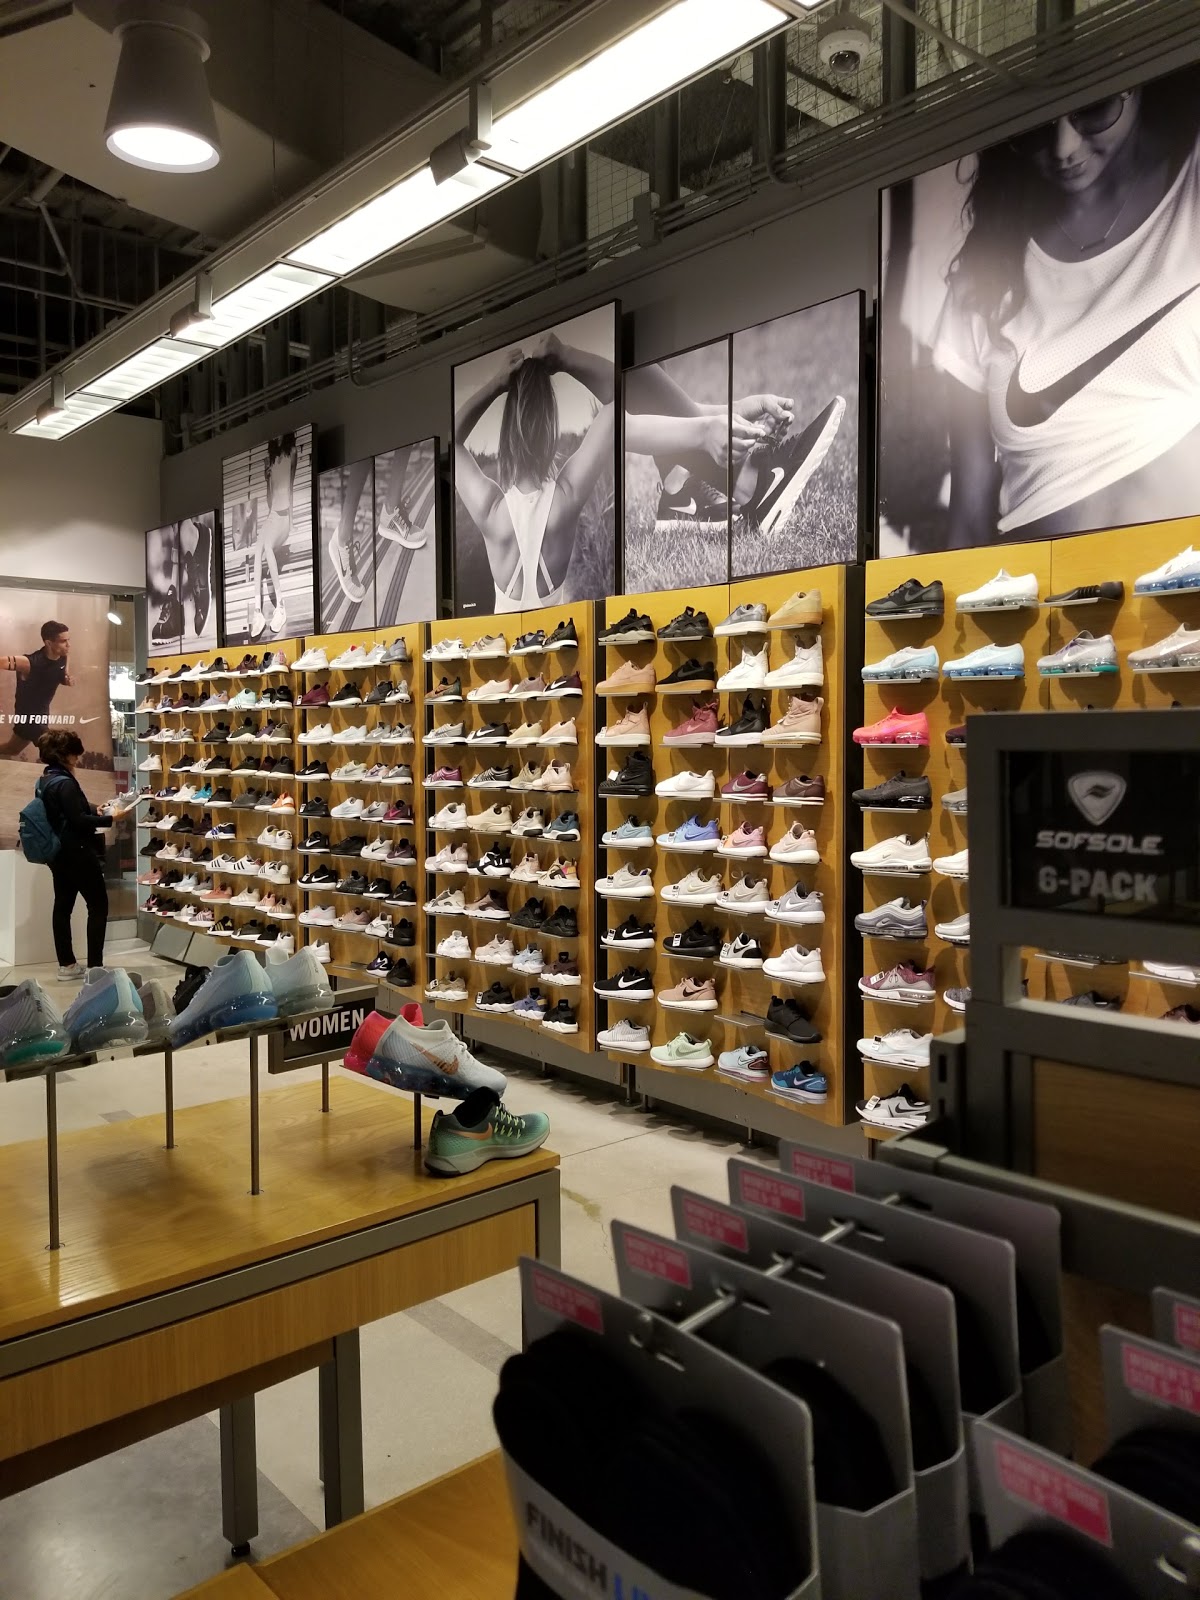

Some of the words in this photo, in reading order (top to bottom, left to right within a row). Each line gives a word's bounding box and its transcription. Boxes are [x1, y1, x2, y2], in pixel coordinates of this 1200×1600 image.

[8, 715, 27, 724] YOU
[29, 715, 75, 724] FORWARD
[1035, 830, 1164, 856] SOFSOLE
[1037, 865, 1159, 904] 6-PACK
[289, 1008, 365, 1042] WOMEN
[526, 1501, 608, 1591] FINISH
